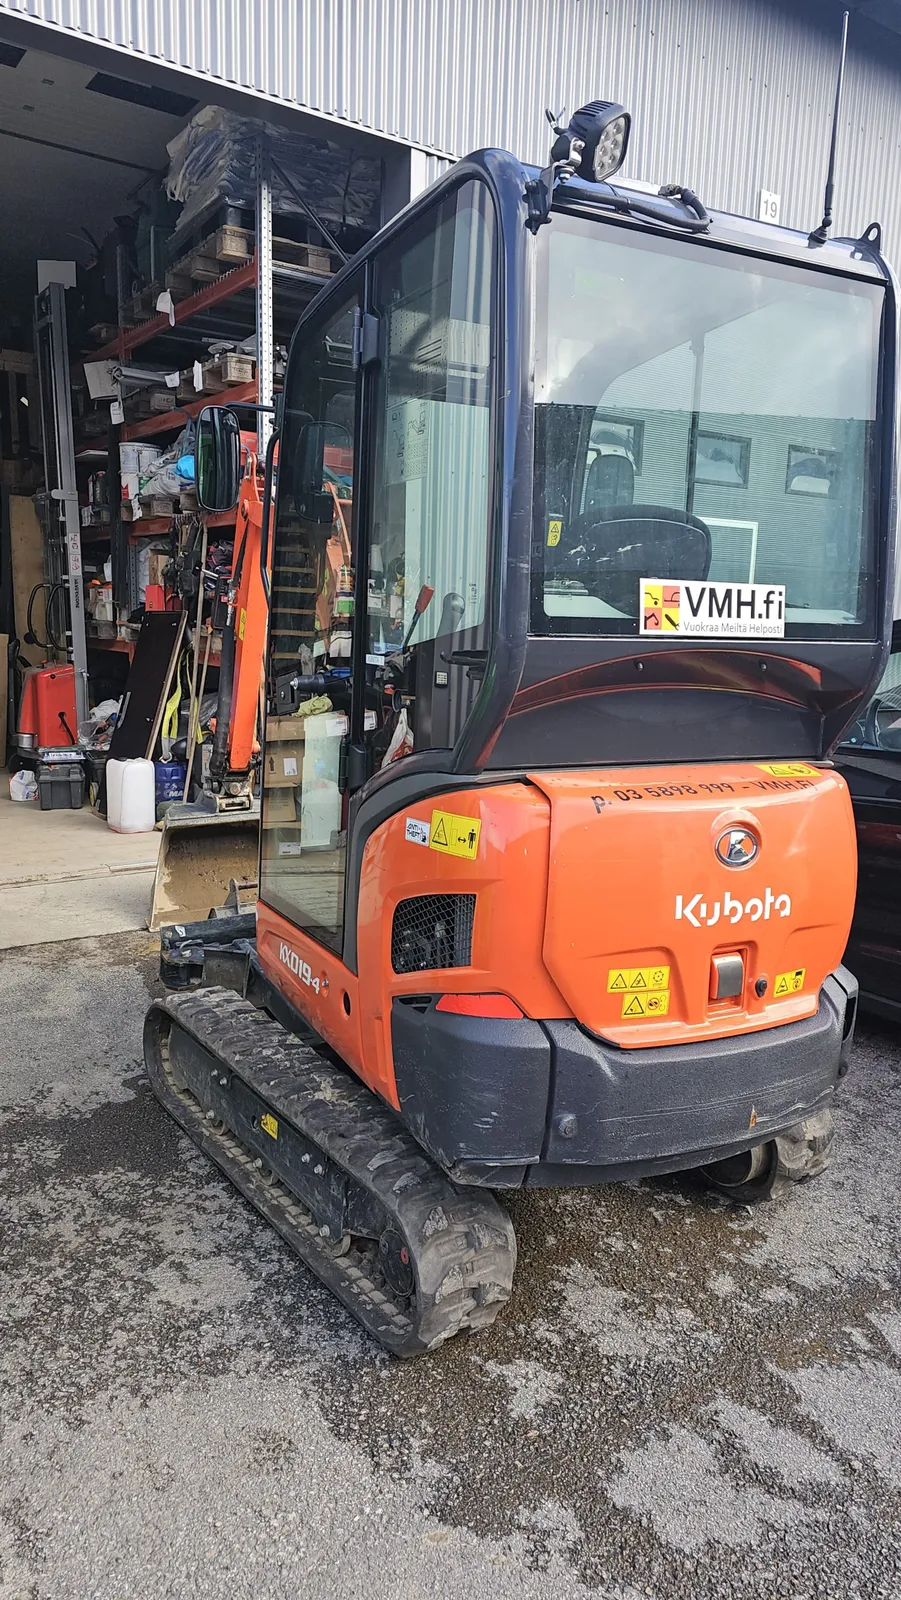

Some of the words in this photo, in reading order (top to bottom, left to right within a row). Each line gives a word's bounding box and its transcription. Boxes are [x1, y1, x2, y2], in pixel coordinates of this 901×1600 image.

[763, 199, 777, 218] 19
[685, 586, 782, 619] VMH.fi
[684, 621, 719, 632] Vuokraa
[721, 622, 747, 633] Meiltä
[749, 623, 783, 635] Helposti
[591, 795, 612, 814] p.
[613, 789, 643, 801] 03
[643, 785, 698, 797] 5898
[699, 782, 735, 793] 999
[407, 829, 421, 838] THEFT
[675, 887, 791, 927] Kubota
[280, 942, 320, 995] KX019-4
